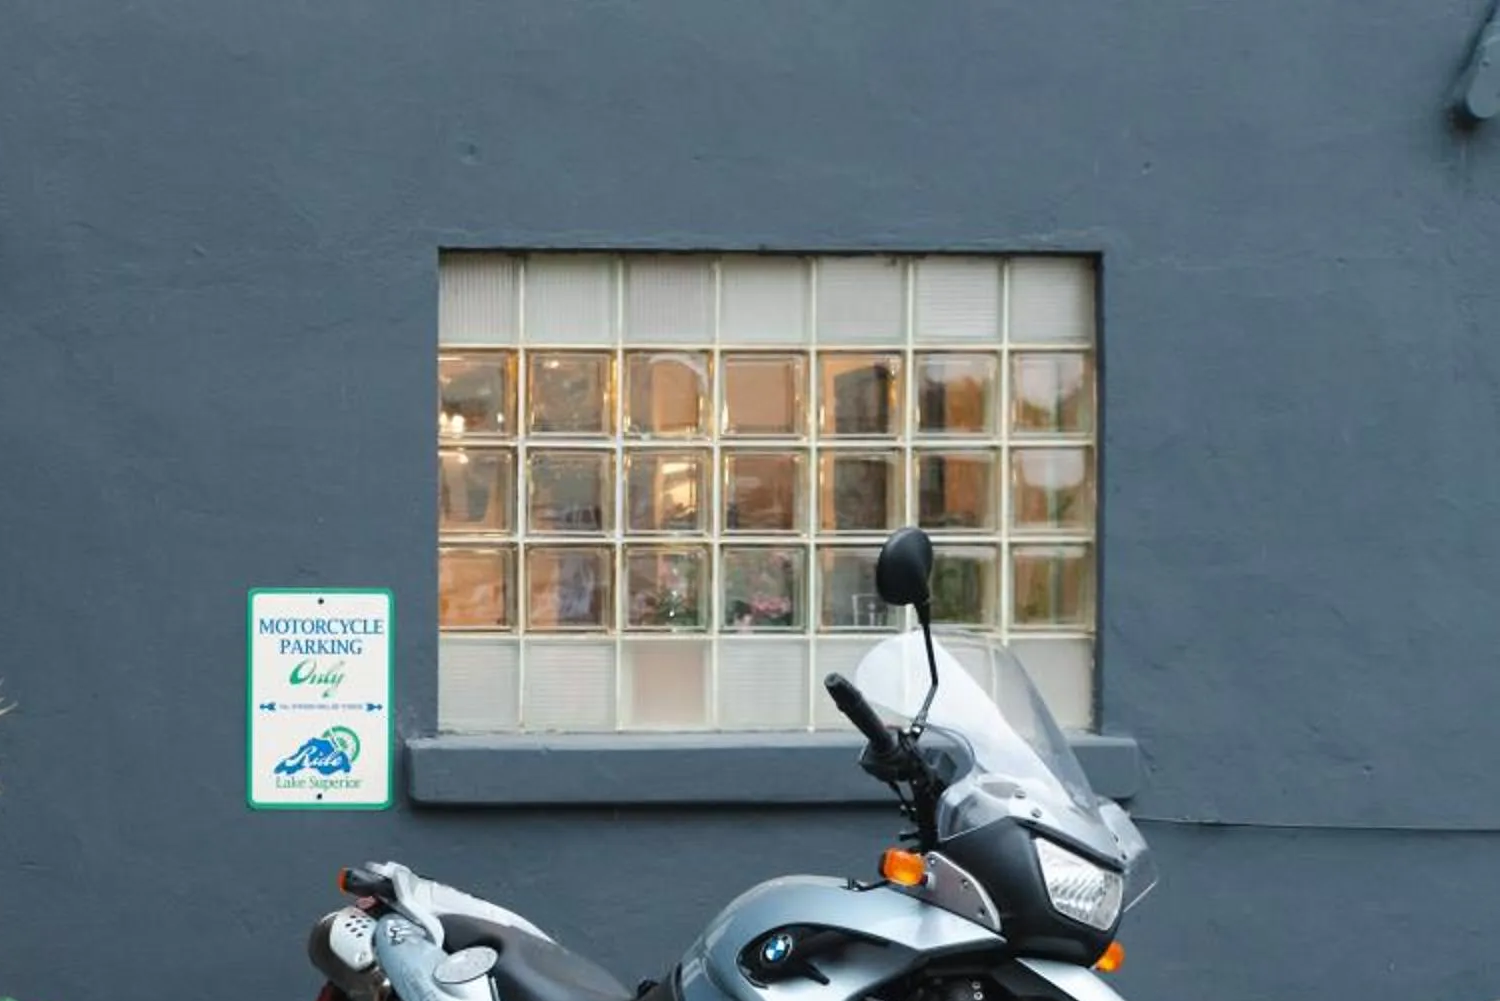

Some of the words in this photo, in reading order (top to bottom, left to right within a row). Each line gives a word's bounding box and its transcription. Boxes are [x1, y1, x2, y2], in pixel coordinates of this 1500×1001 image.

[258, 618, 385, 635] MOTORCYCLE
[279, 639, 364, 655] PARKING
[289, 659, 346, 699] Only
[285, 744, 343, 769] Ride
[275, 776, 306, 789] Lake
[309, 776, 361, 792] Superior
